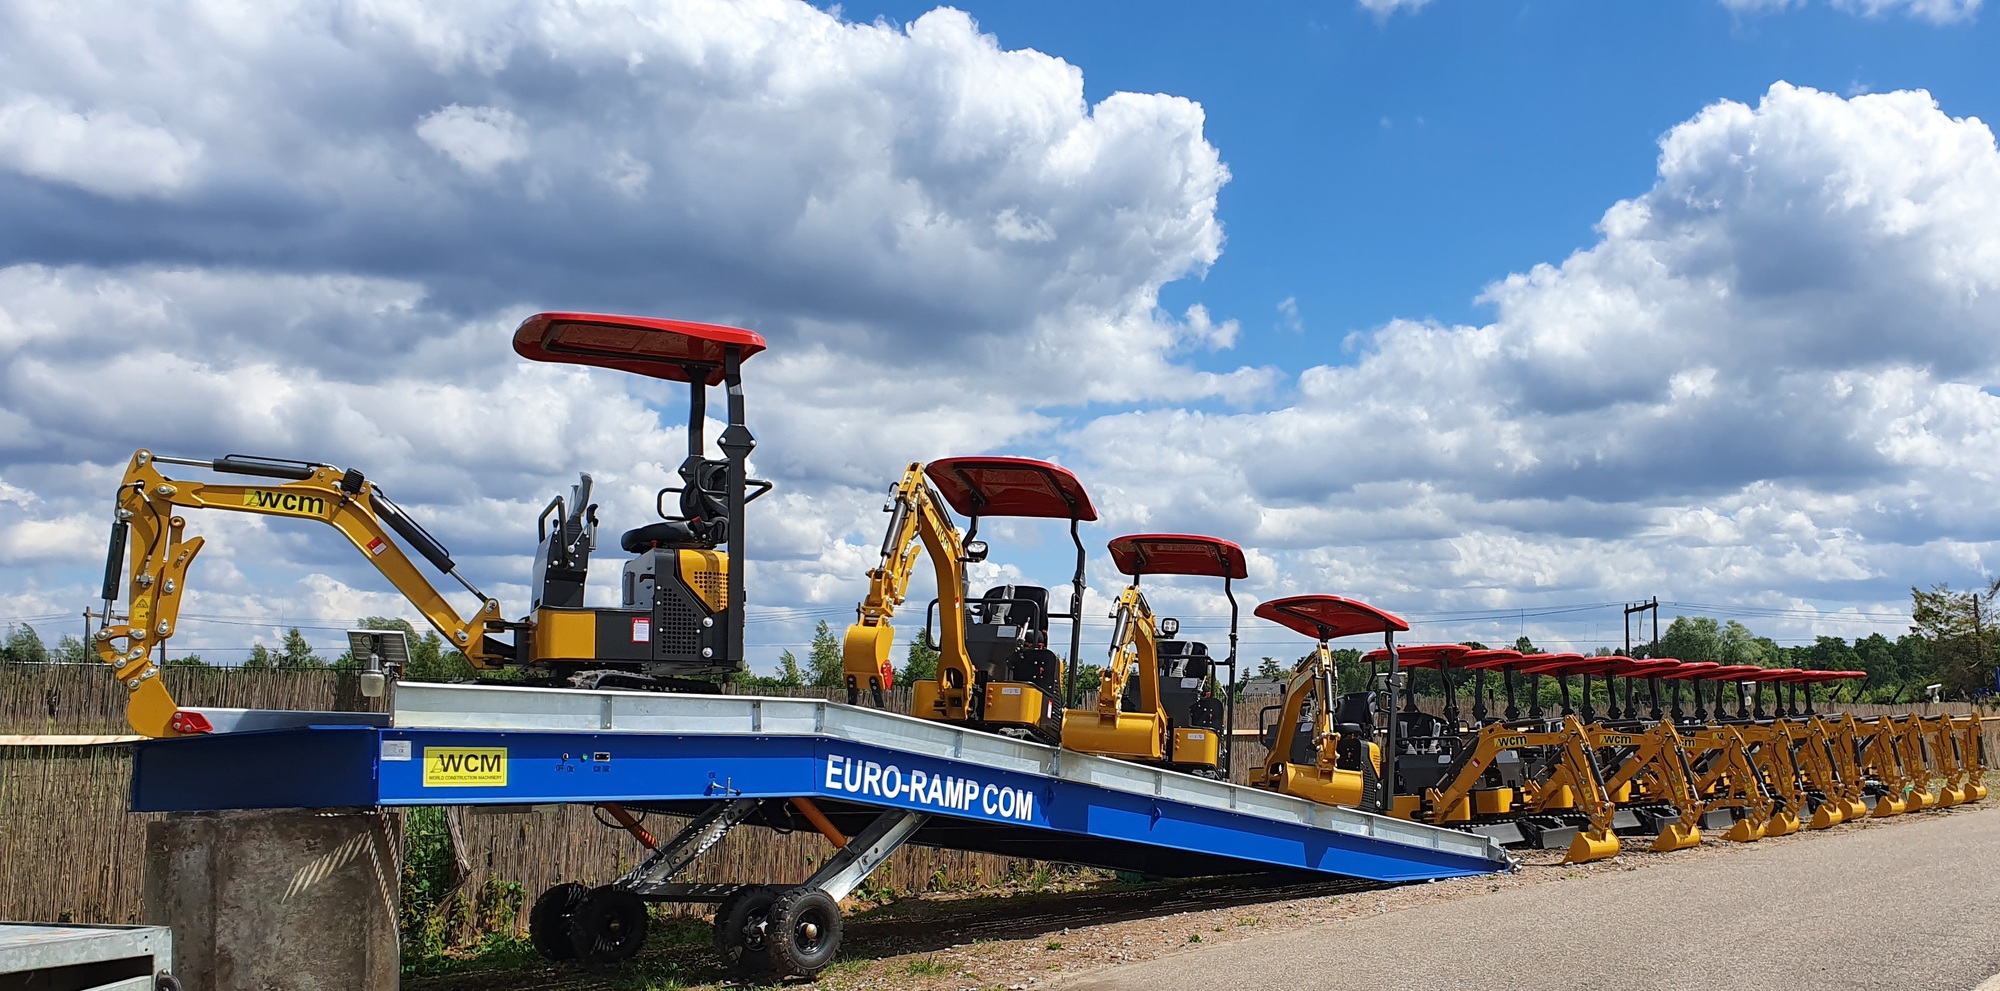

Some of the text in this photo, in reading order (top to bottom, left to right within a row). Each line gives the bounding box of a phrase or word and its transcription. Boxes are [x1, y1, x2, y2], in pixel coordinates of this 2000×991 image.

[255, 490, 324, 514] wcm
[1498, 735, 1527, 746] wcm
[1604, 735, 1632, 745] wcm
[439, 754, 501, 772] WCM
[825, 754, 1033, 821] EURO-RAMP COM
